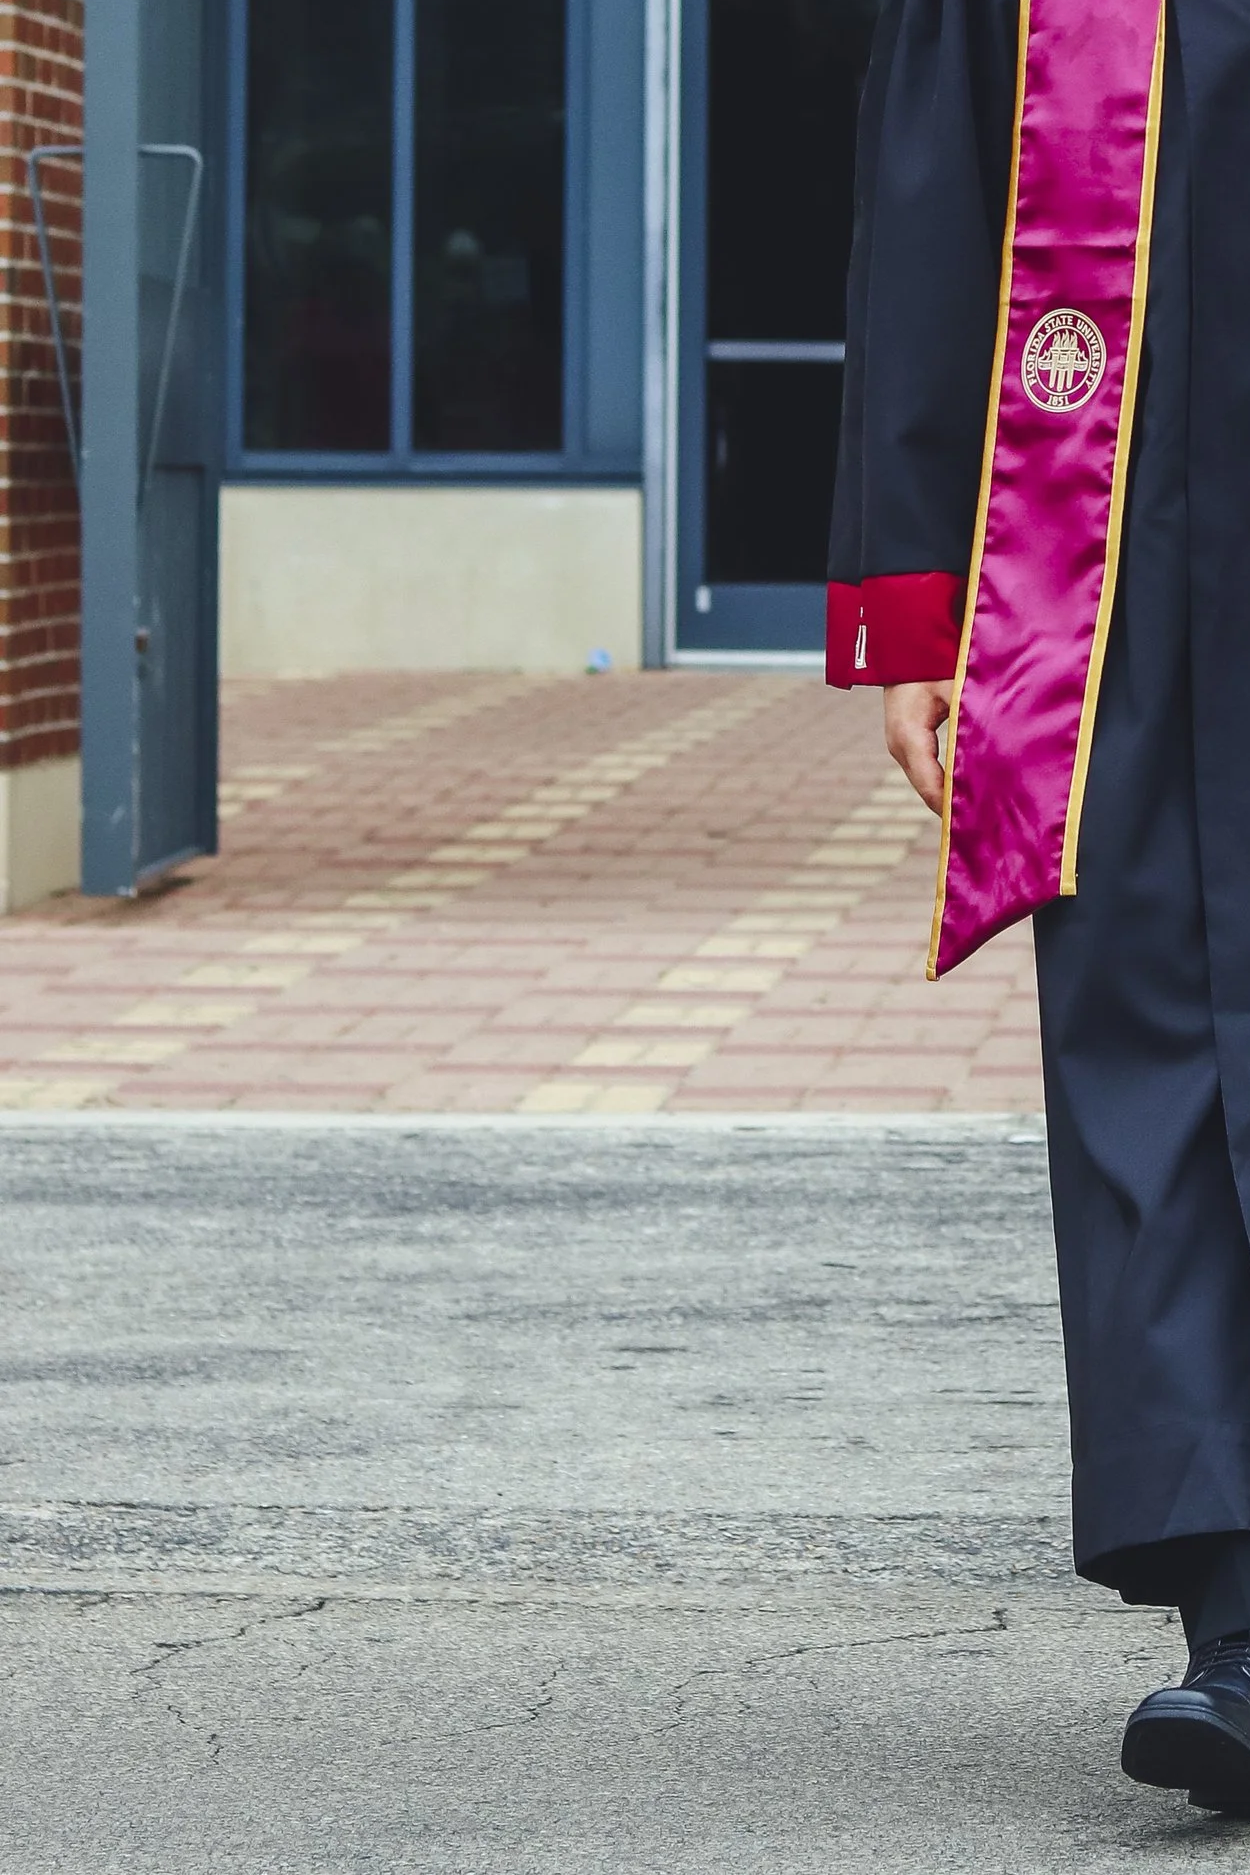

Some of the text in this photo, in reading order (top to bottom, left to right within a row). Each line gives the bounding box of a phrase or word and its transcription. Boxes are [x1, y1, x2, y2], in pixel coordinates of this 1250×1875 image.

[1025, 315, 1101, 390] FLORIDA STATE UNIVERSITY
[1046, 395, 1070, 407] 1851
